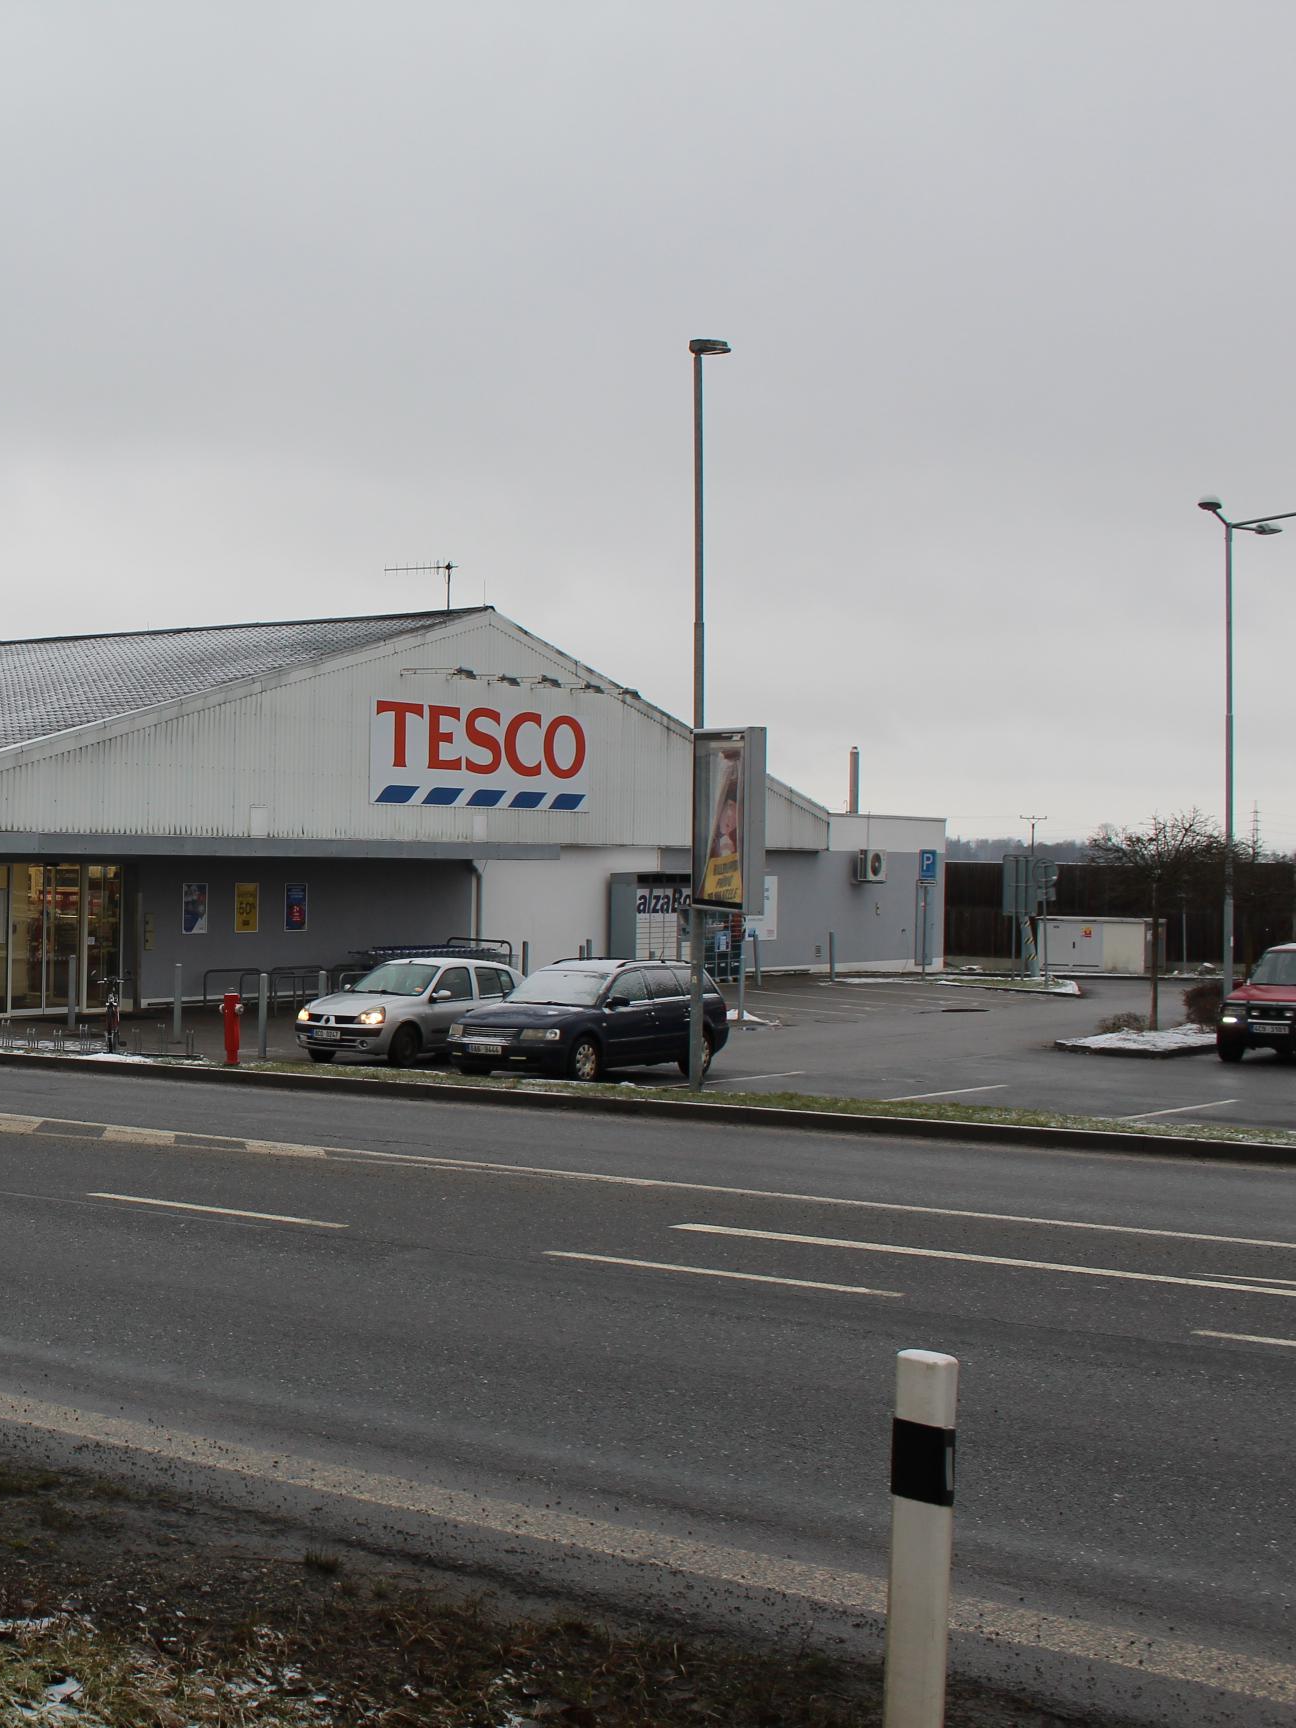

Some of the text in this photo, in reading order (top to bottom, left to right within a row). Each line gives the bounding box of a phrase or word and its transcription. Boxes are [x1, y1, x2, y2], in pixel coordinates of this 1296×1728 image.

[376, 700, 586, 779] TESCO
[923, 853, 933, 871] P
[637, 888, 692, 914] alzaBo
